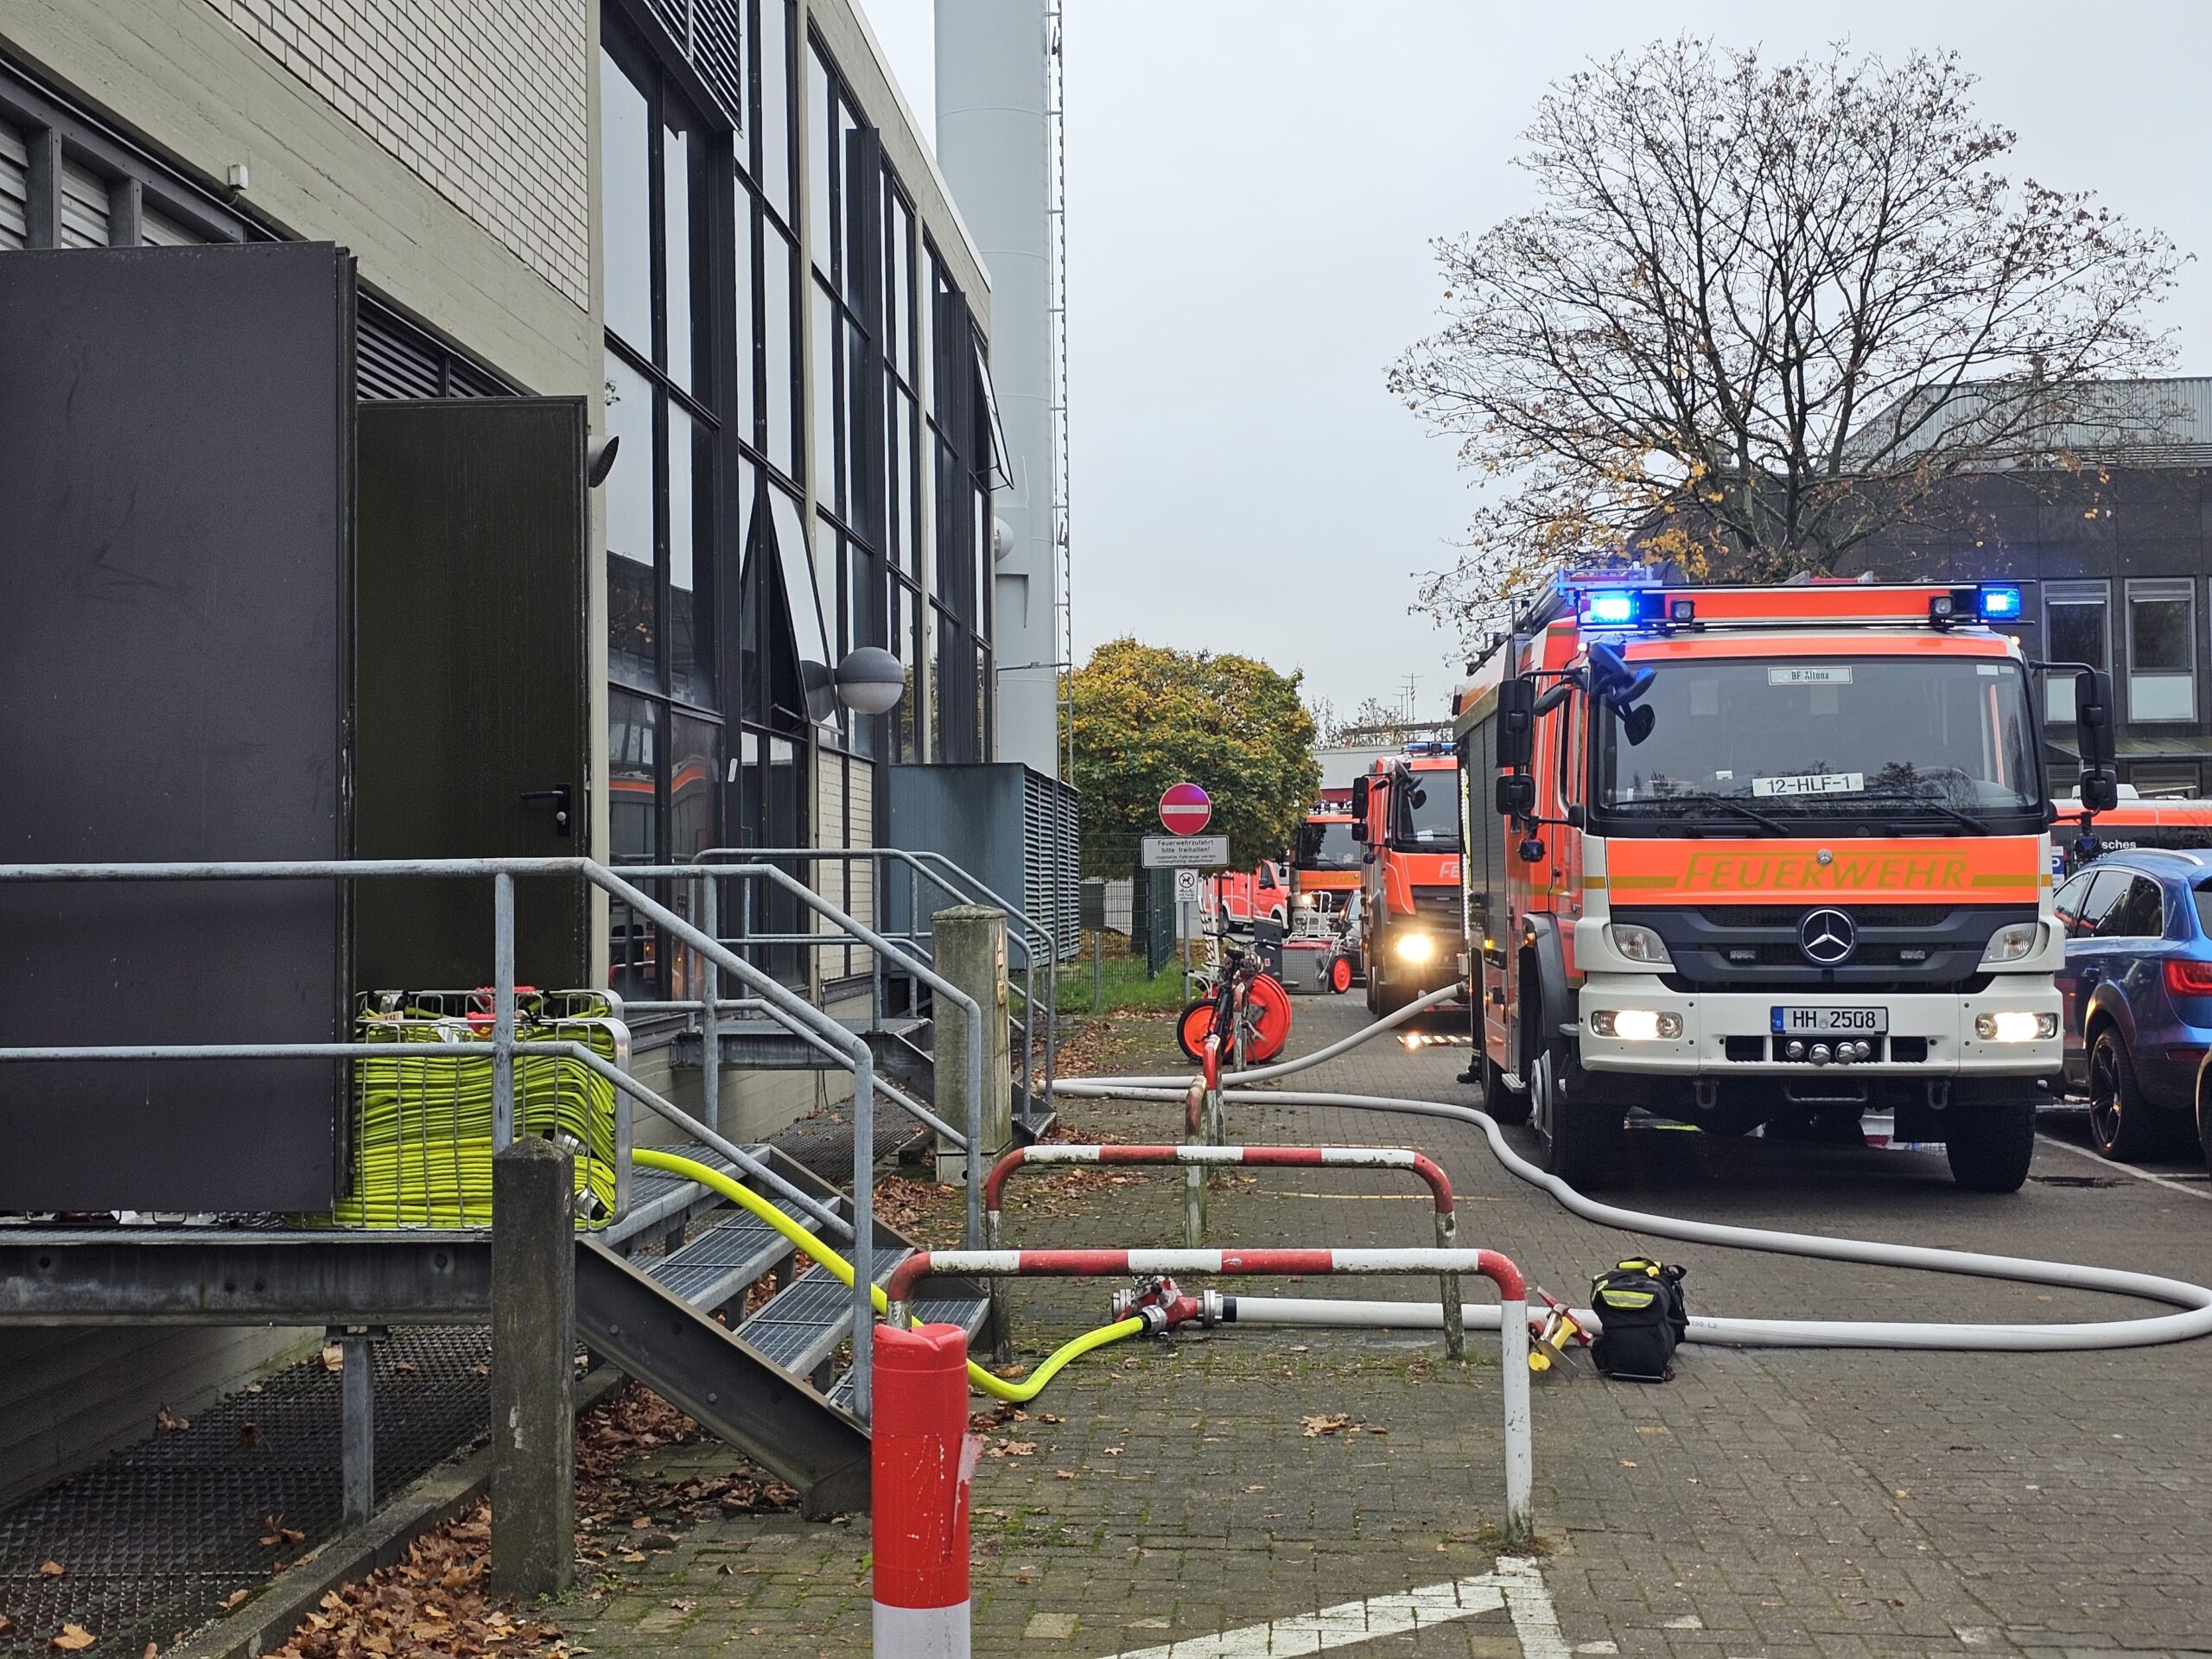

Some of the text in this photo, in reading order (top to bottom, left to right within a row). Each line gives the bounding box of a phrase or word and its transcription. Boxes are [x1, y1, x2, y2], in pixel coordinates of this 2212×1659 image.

[1791, 671, 1829, 680] BF Altona
[1767, 775, 1850, 794] 12-HLF-1
[1683, 850, 1968, 889] FEUERWEHR
[1793, 1010, 1876, 1028] HH 2508
